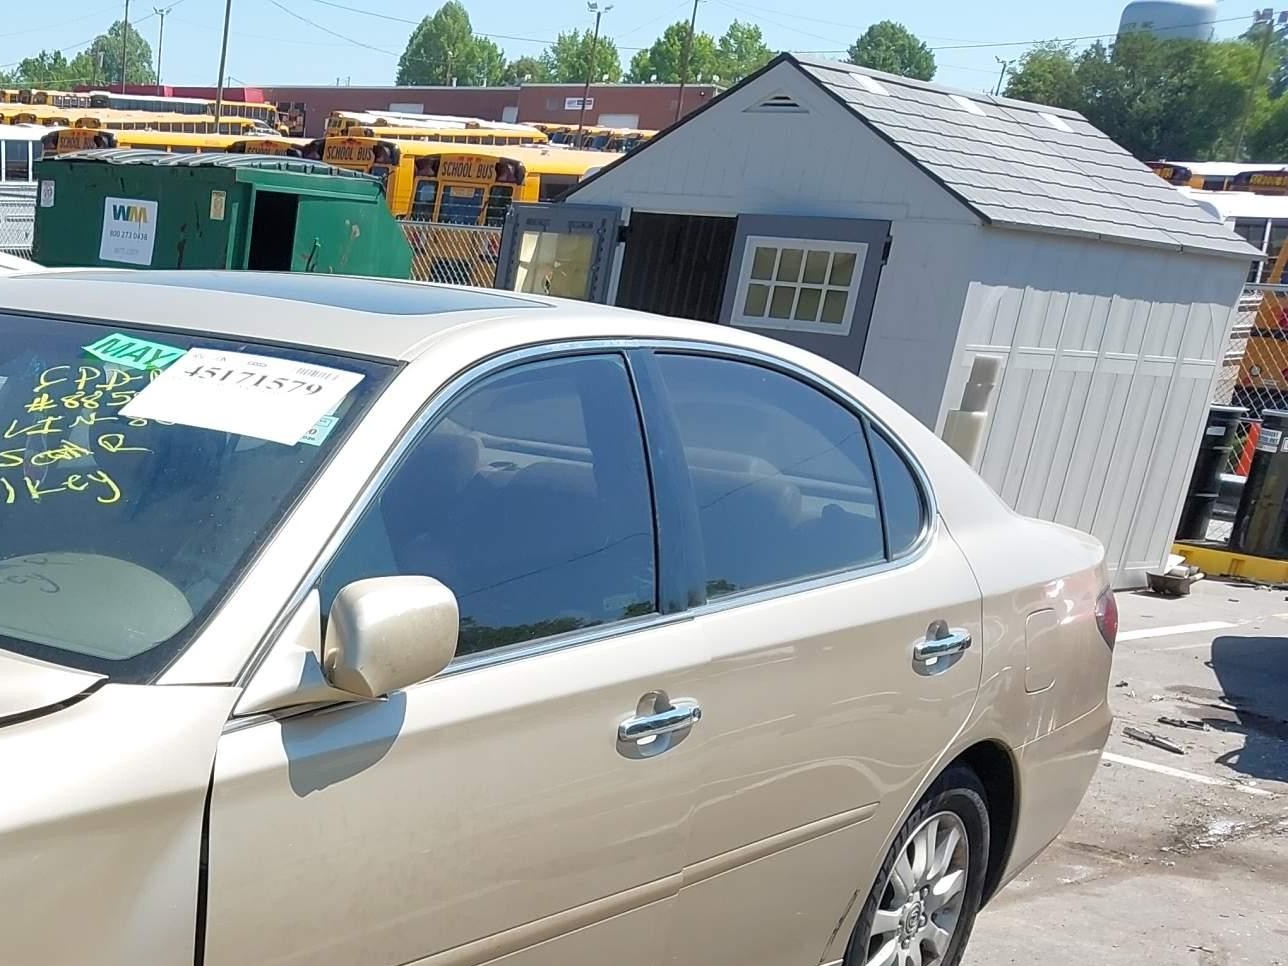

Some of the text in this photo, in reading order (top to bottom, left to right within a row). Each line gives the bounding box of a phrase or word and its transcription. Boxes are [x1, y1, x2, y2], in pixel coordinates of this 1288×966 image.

[326, 144, 374, 161] SCHOOL BUS
[441, 161, 495, 179] SCHOOL BUS
[112, 204, 148, 224] WM
[93, 338, 178, 365] MAY
[184, 365, 324, 396] 45171579
